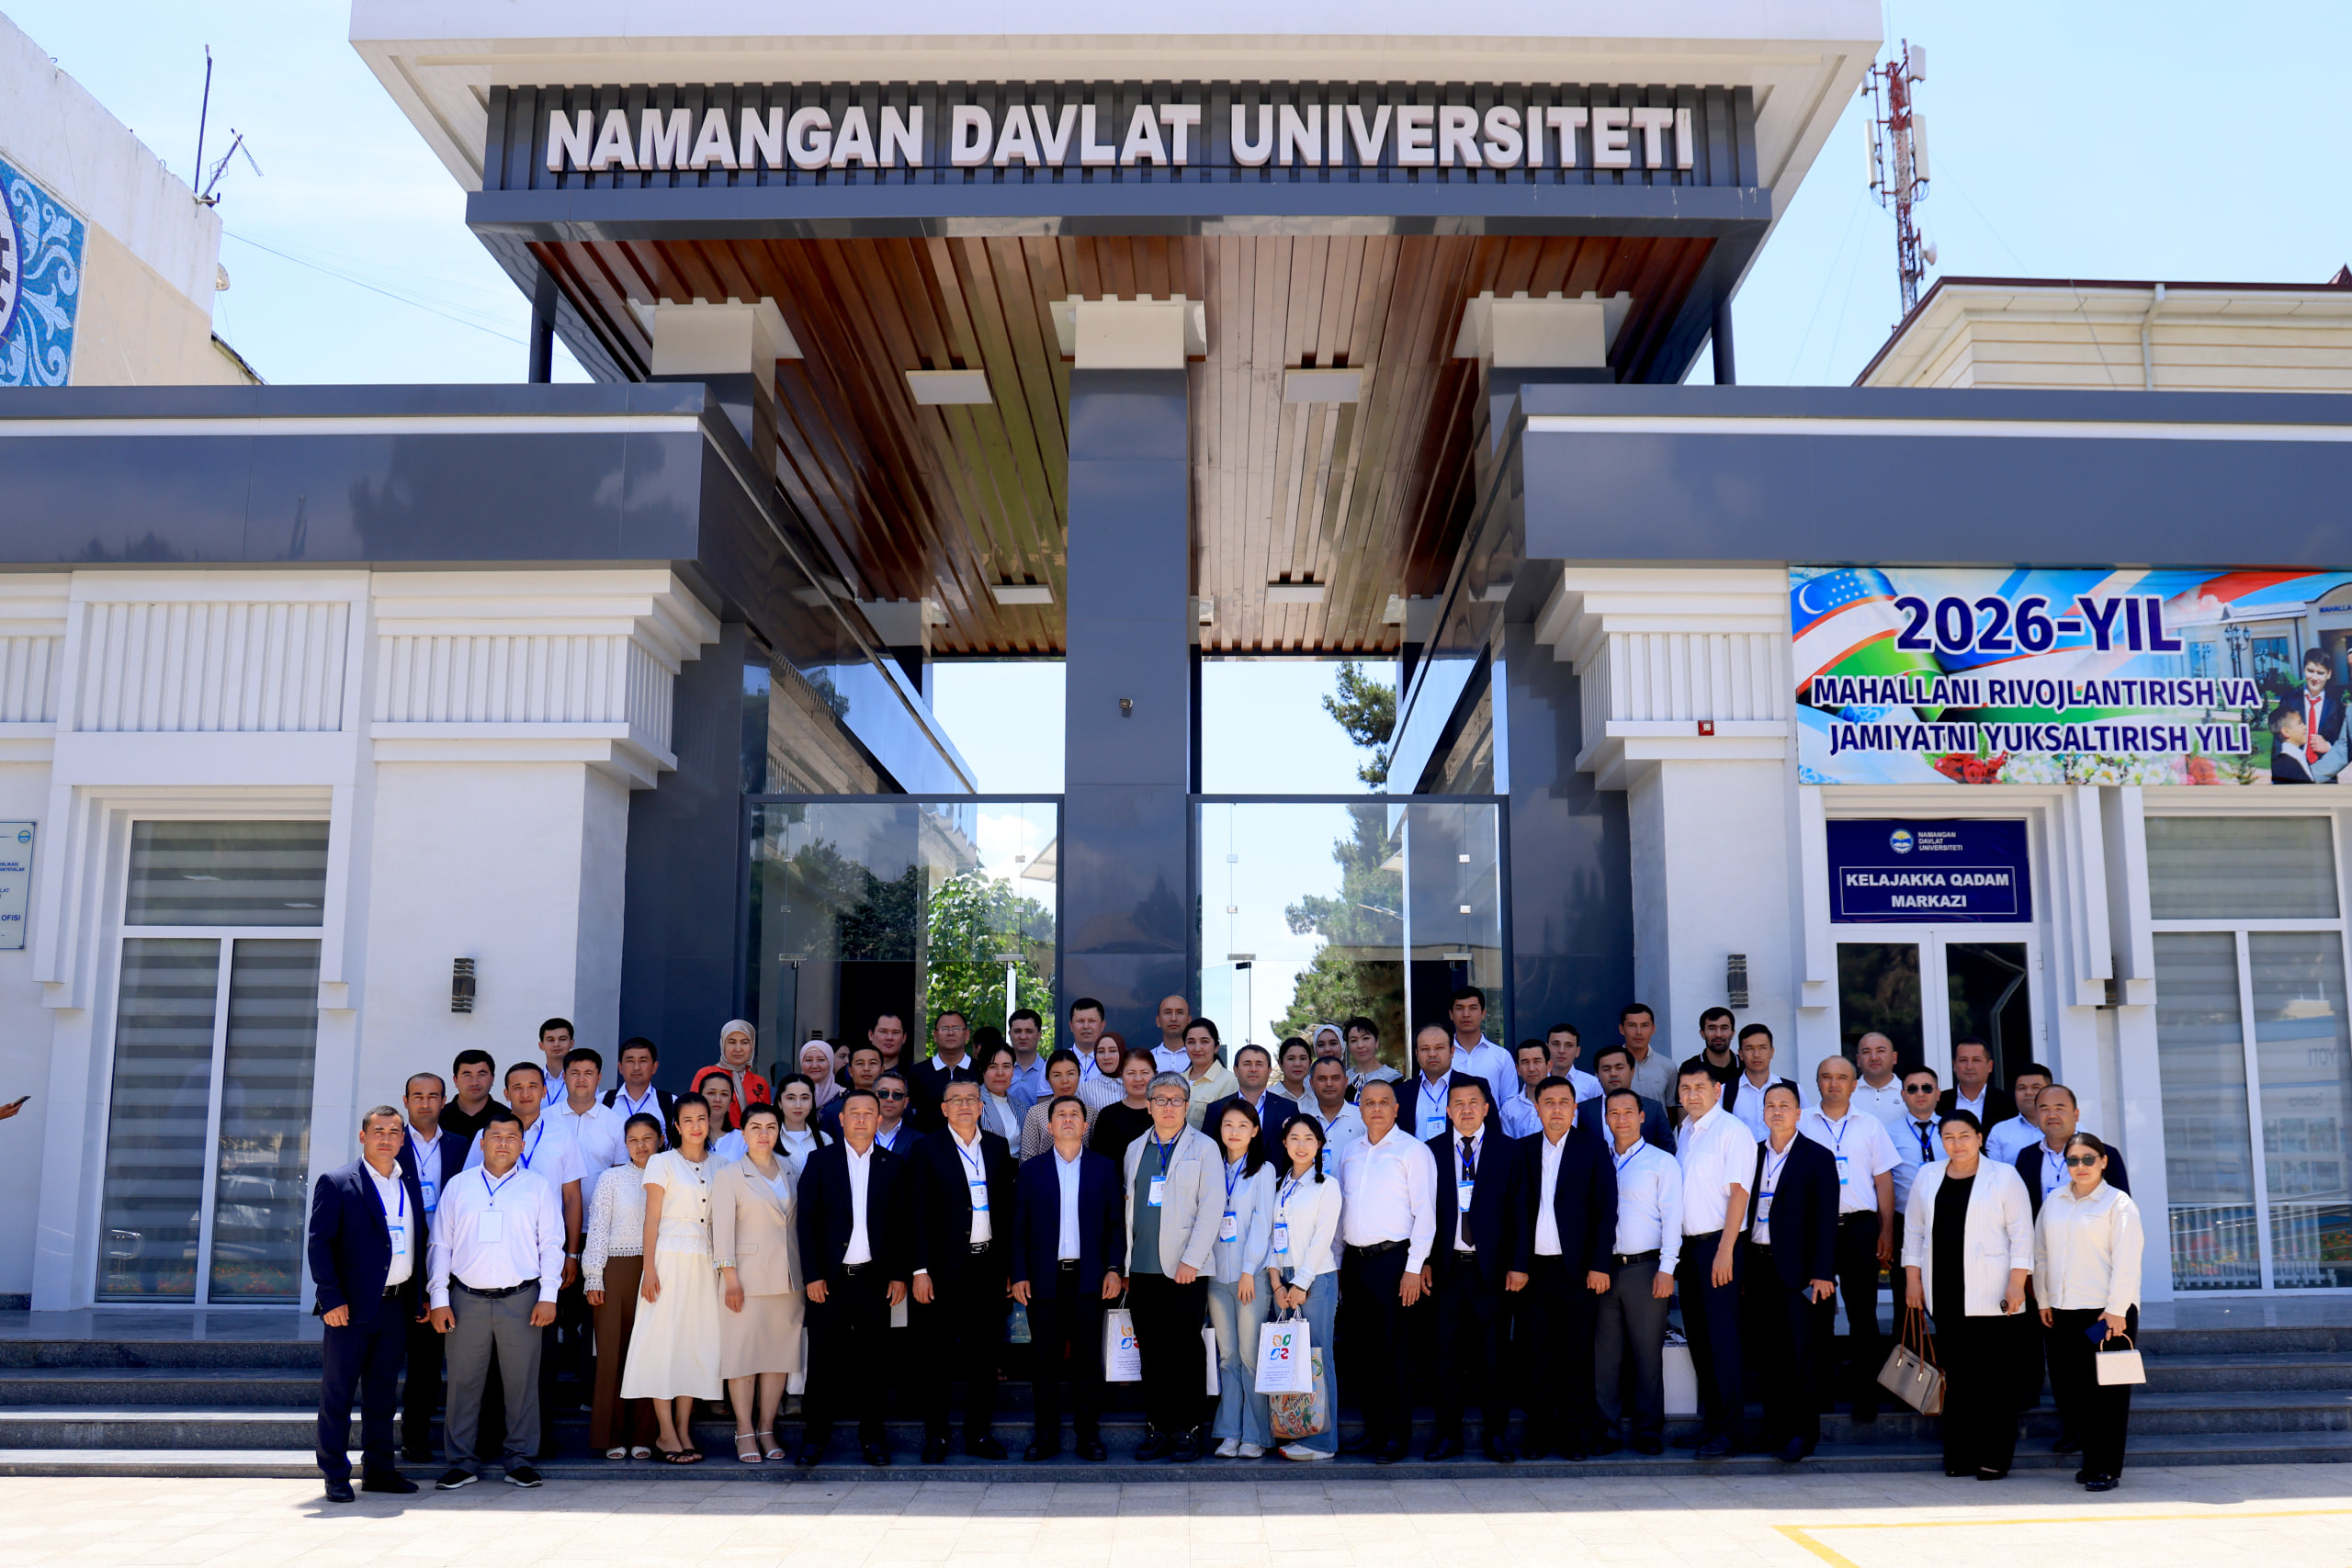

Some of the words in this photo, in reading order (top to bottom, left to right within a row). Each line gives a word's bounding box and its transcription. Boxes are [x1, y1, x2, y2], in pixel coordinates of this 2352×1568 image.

[547, 106, 923, 171] NAMANGAN
[951, 104, 1201, 168] DAVLAT
[1230, 104, 1693, 169] UNIVERSITETI
[1894, 596, 2181, 651] 2026-YIL
[1814, 678, 1980, 705] MAHALLANI
[1988, 679, 2214, 711] RIVOJLANTIRISH
[2222, 681, 2260, 706] VA
[1829, 724, 1975, 756] JAMIYATNI
[1983, 725, 2188, 752] YUKSALTIRISH
[2194, 726, 2249, 751] YILI
[1846, 874, 1947, 886] KELAJAKKA
[1950, 874, 2010, 887] QADAM
[1891, 895, 1967, 908] MARKAZI
